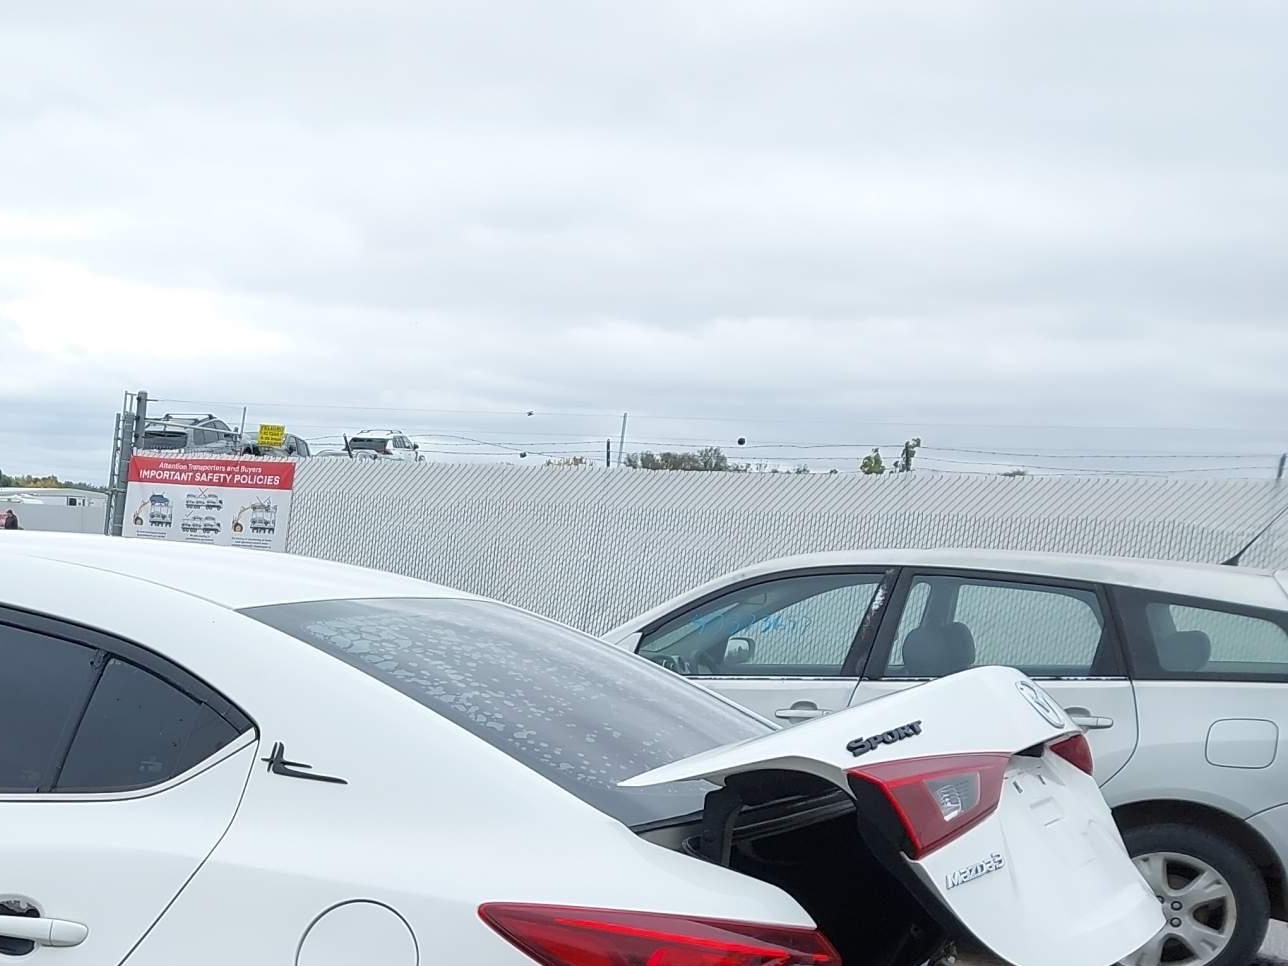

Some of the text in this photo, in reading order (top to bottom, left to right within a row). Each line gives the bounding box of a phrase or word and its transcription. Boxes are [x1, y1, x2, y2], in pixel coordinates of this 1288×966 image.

[159, 461, 262, 474] Attention Transporters and Buyers
[139, 469, 281, 485] IMPORTANT SAFETY POLICIES
[846, 720, 922, 757] SPORT
